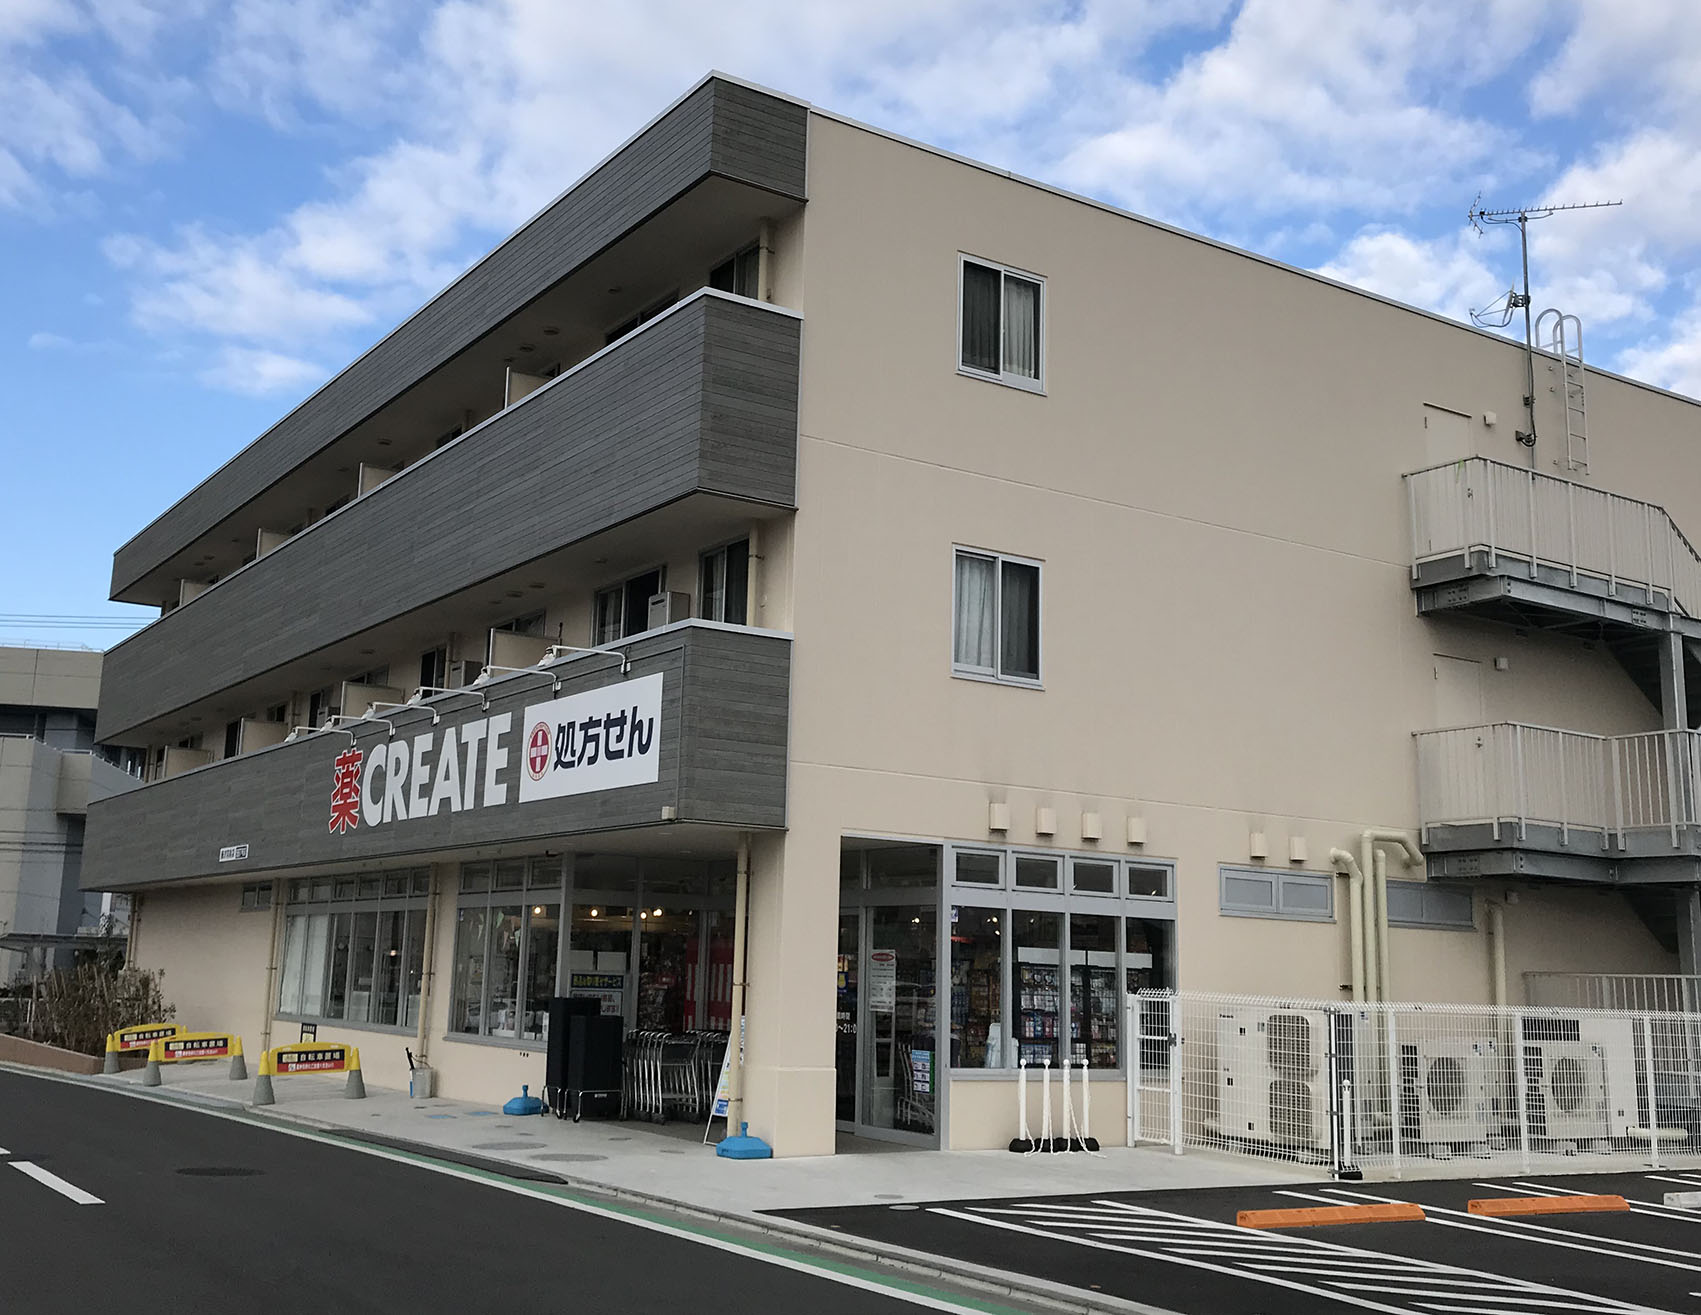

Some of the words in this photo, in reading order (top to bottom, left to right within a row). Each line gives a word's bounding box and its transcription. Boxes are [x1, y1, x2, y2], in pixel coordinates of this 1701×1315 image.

[328, 747, 363, 835] 薬
[362, 712, 513, 827] CREATE
[553, 705, 655, 772] 処方せん
